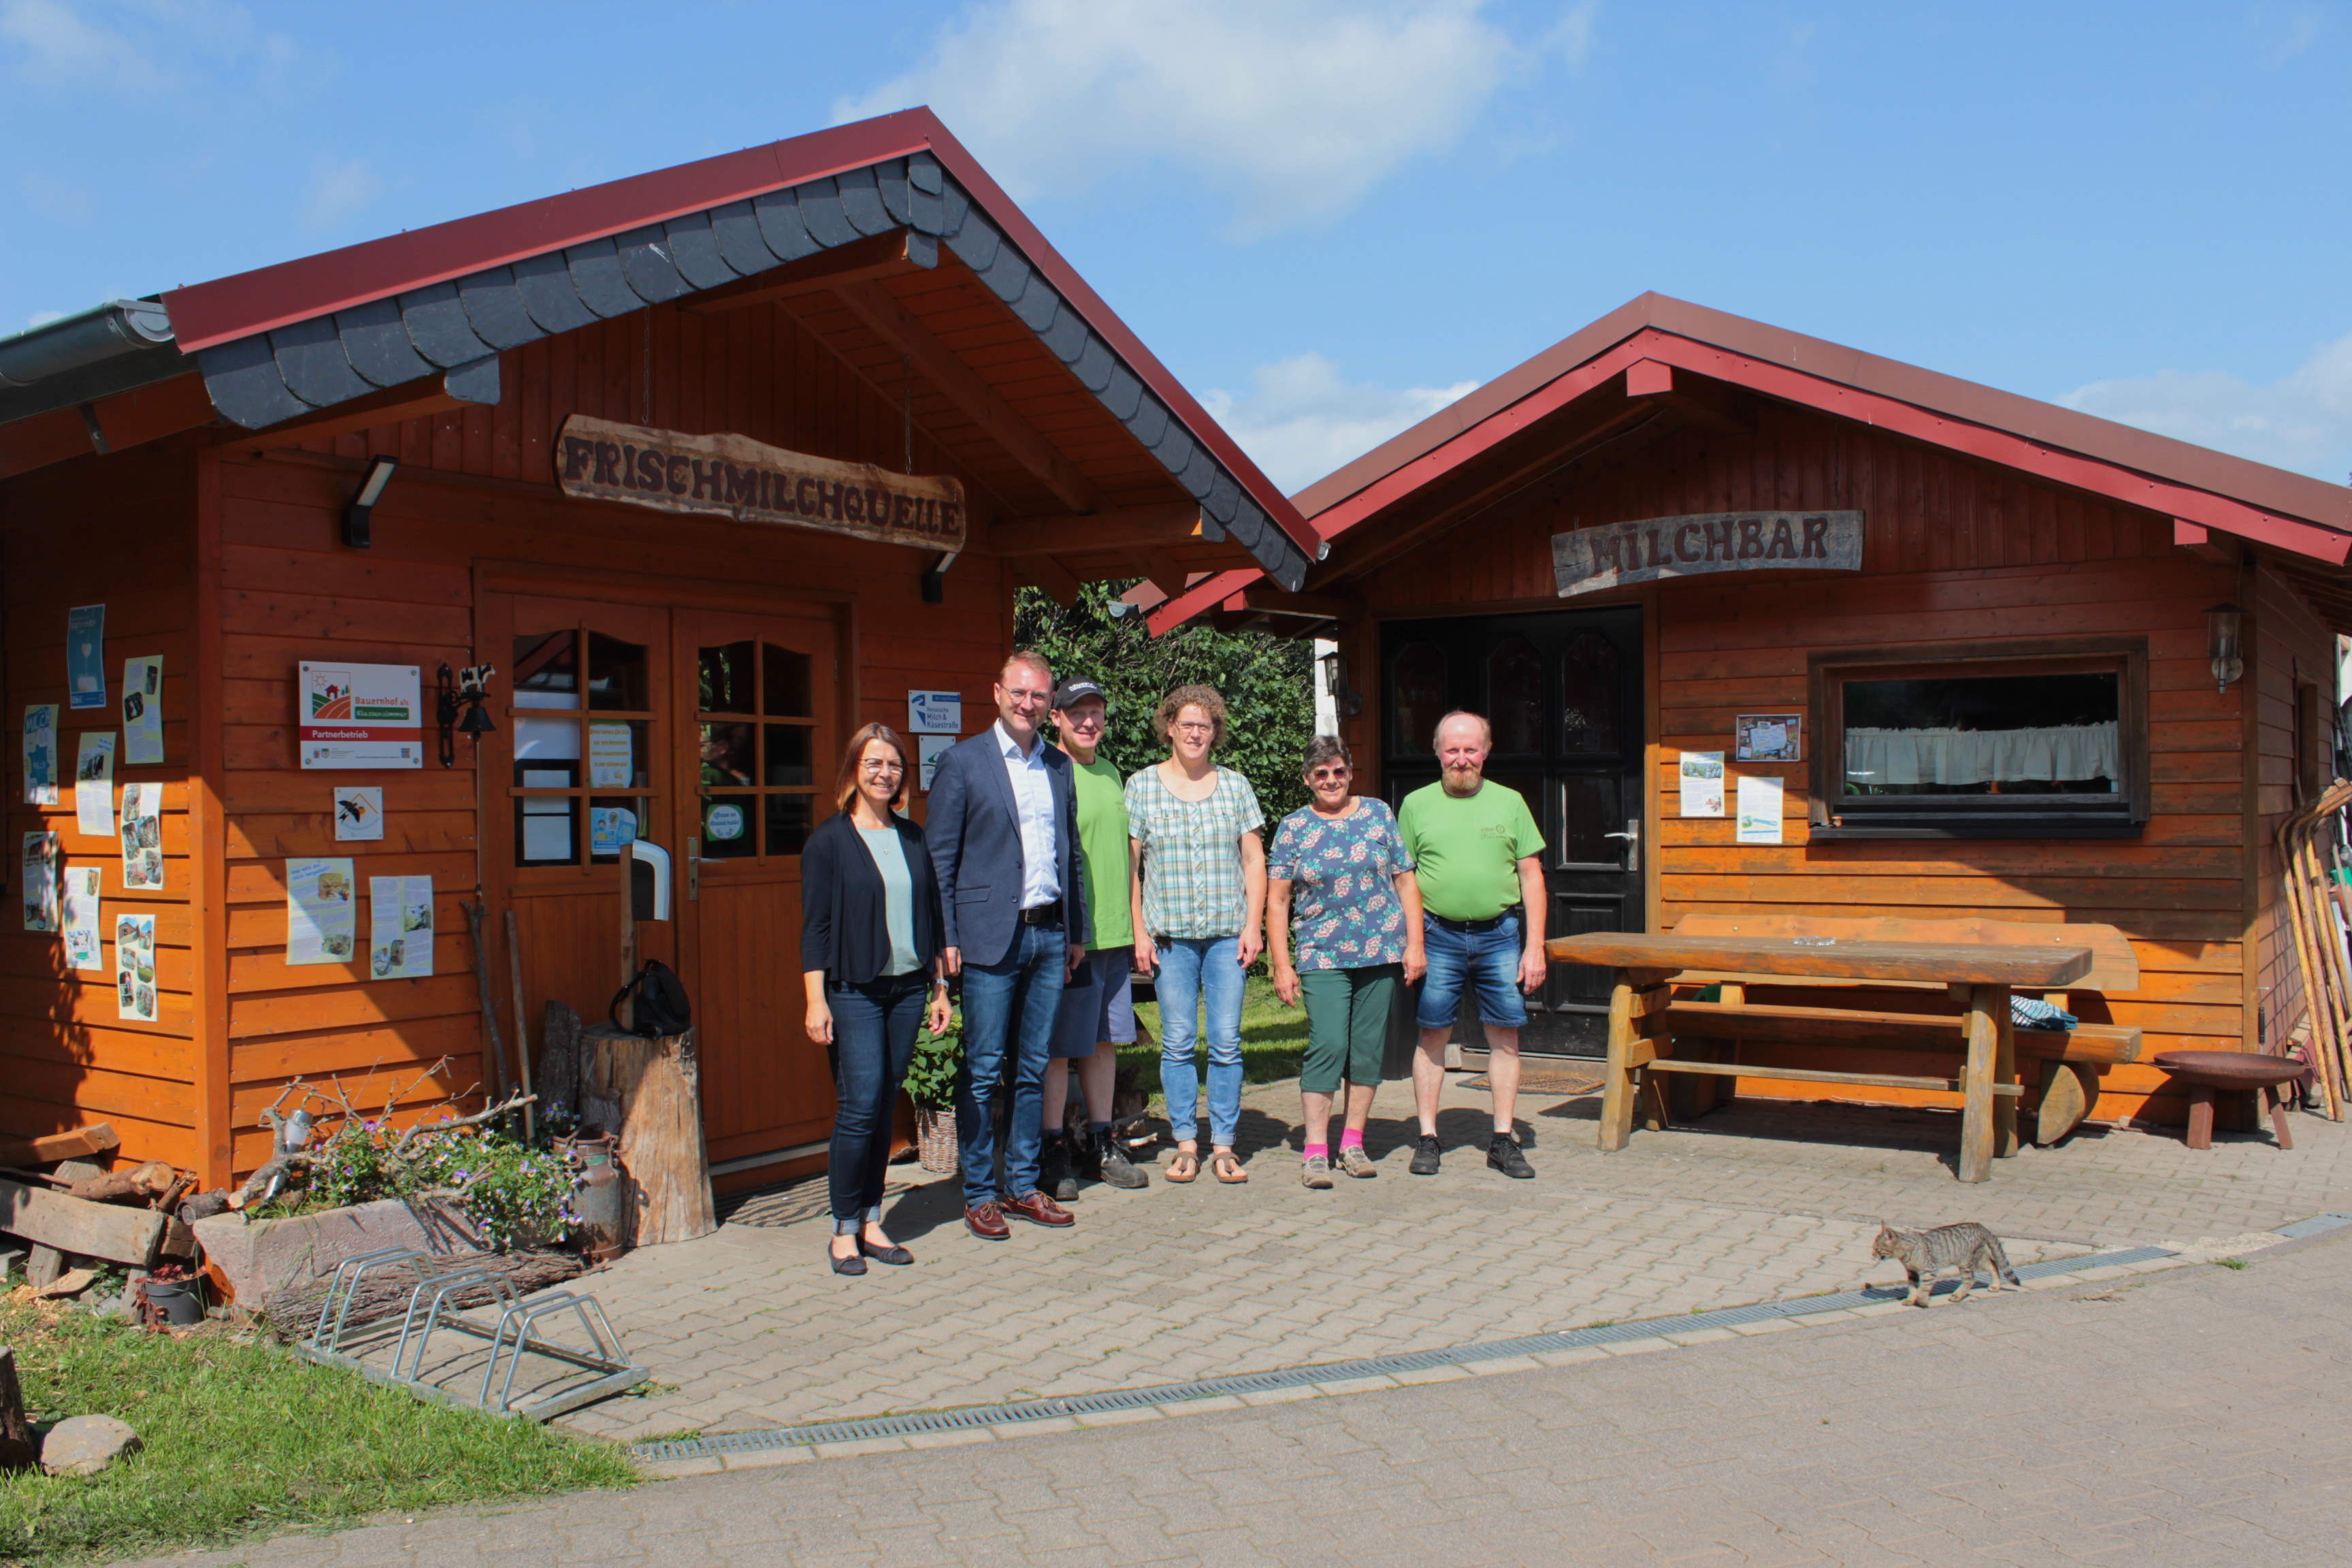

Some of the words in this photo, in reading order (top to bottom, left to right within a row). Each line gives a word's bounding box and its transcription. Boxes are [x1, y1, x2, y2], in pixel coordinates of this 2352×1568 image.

[564, 436, 960, 536] FRISCHMILCHQUELLE
[1590, 517, 1829, 578] MILCHBAR
[355, 696, 398, 706] Bauernhof
[926, 721, 959, 730] Käsestraße
[312, 730, 369, 739] Partnerbetrieb
